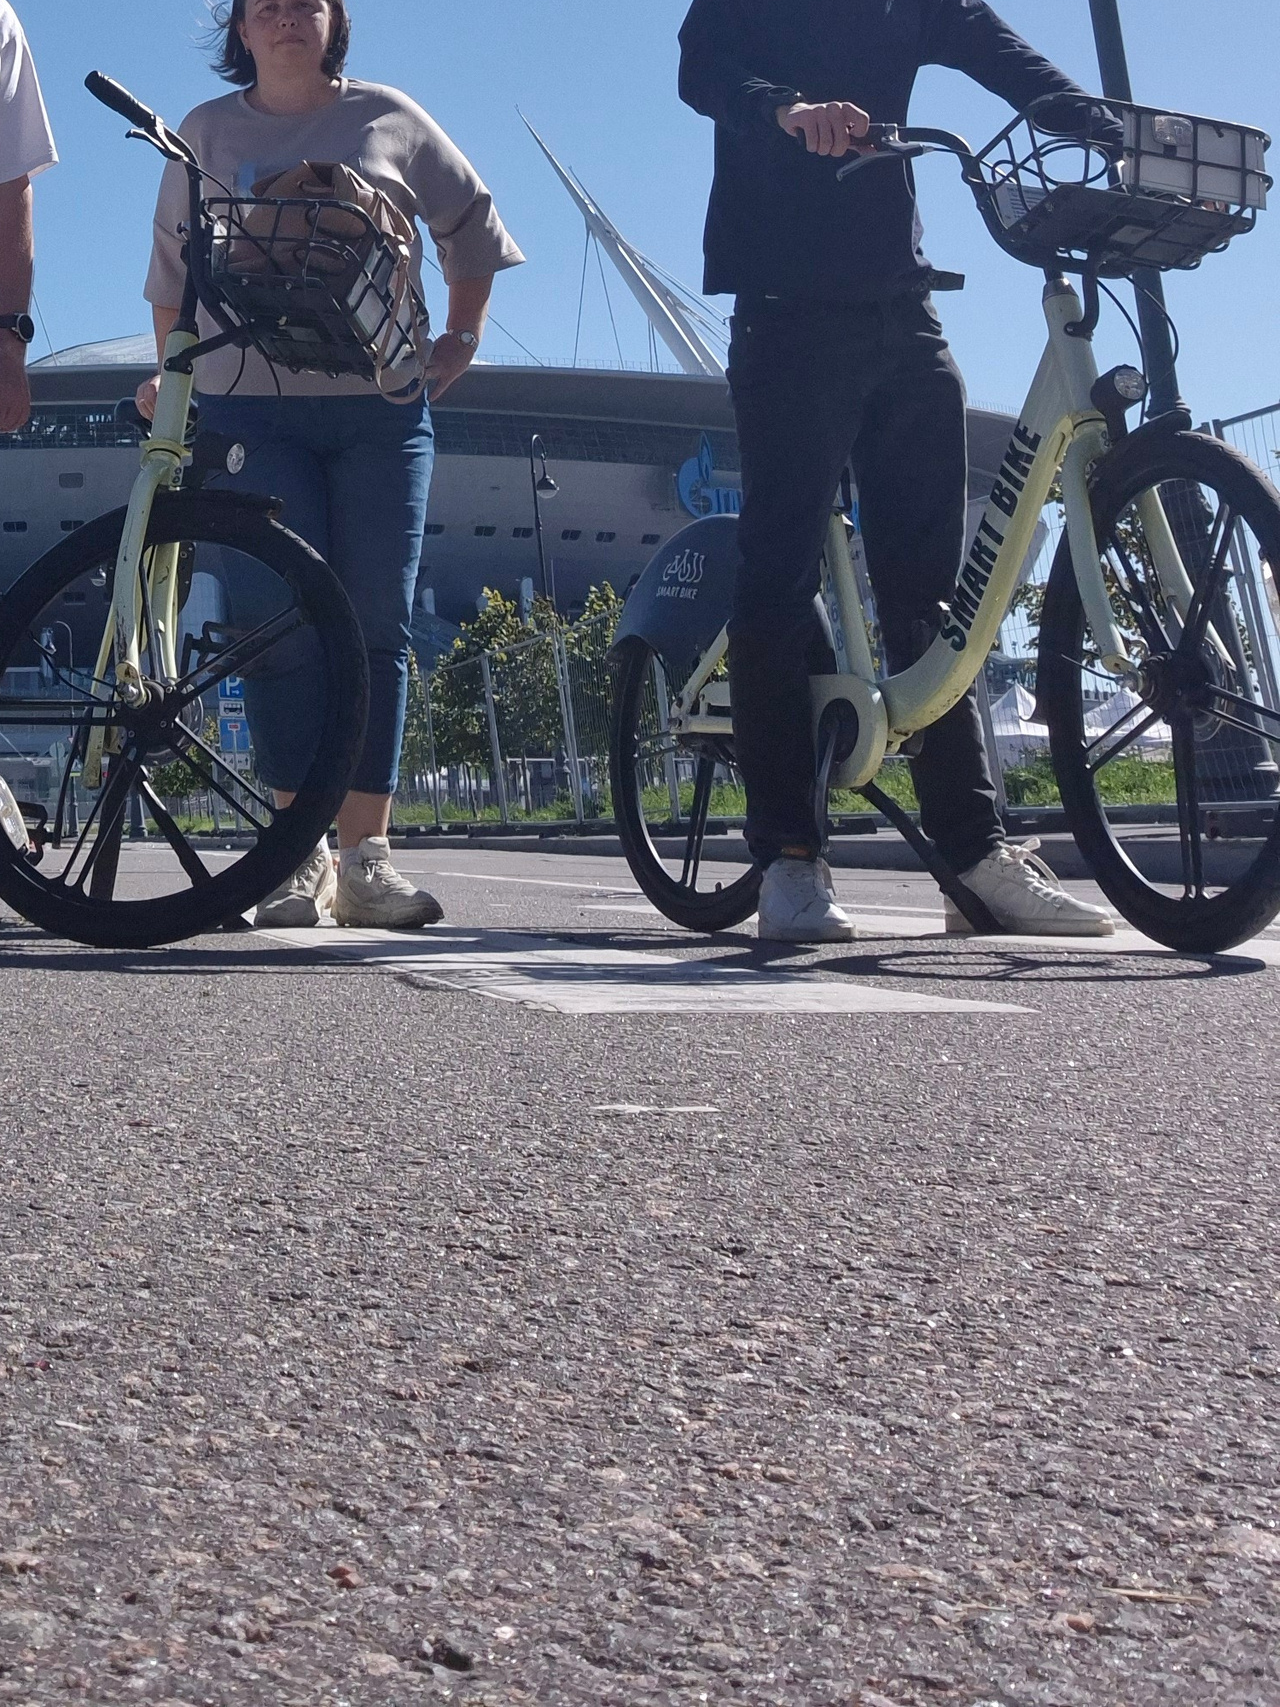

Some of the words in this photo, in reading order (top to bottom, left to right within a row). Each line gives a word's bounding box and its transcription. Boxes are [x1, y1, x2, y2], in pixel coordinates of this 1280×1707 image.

[656, 586, 680, 598] SMART
[679, 587, 699, 600] BIKE
[940, 512, 1005, 652] SMART
[989, 419, 1042, 518] BIKE
